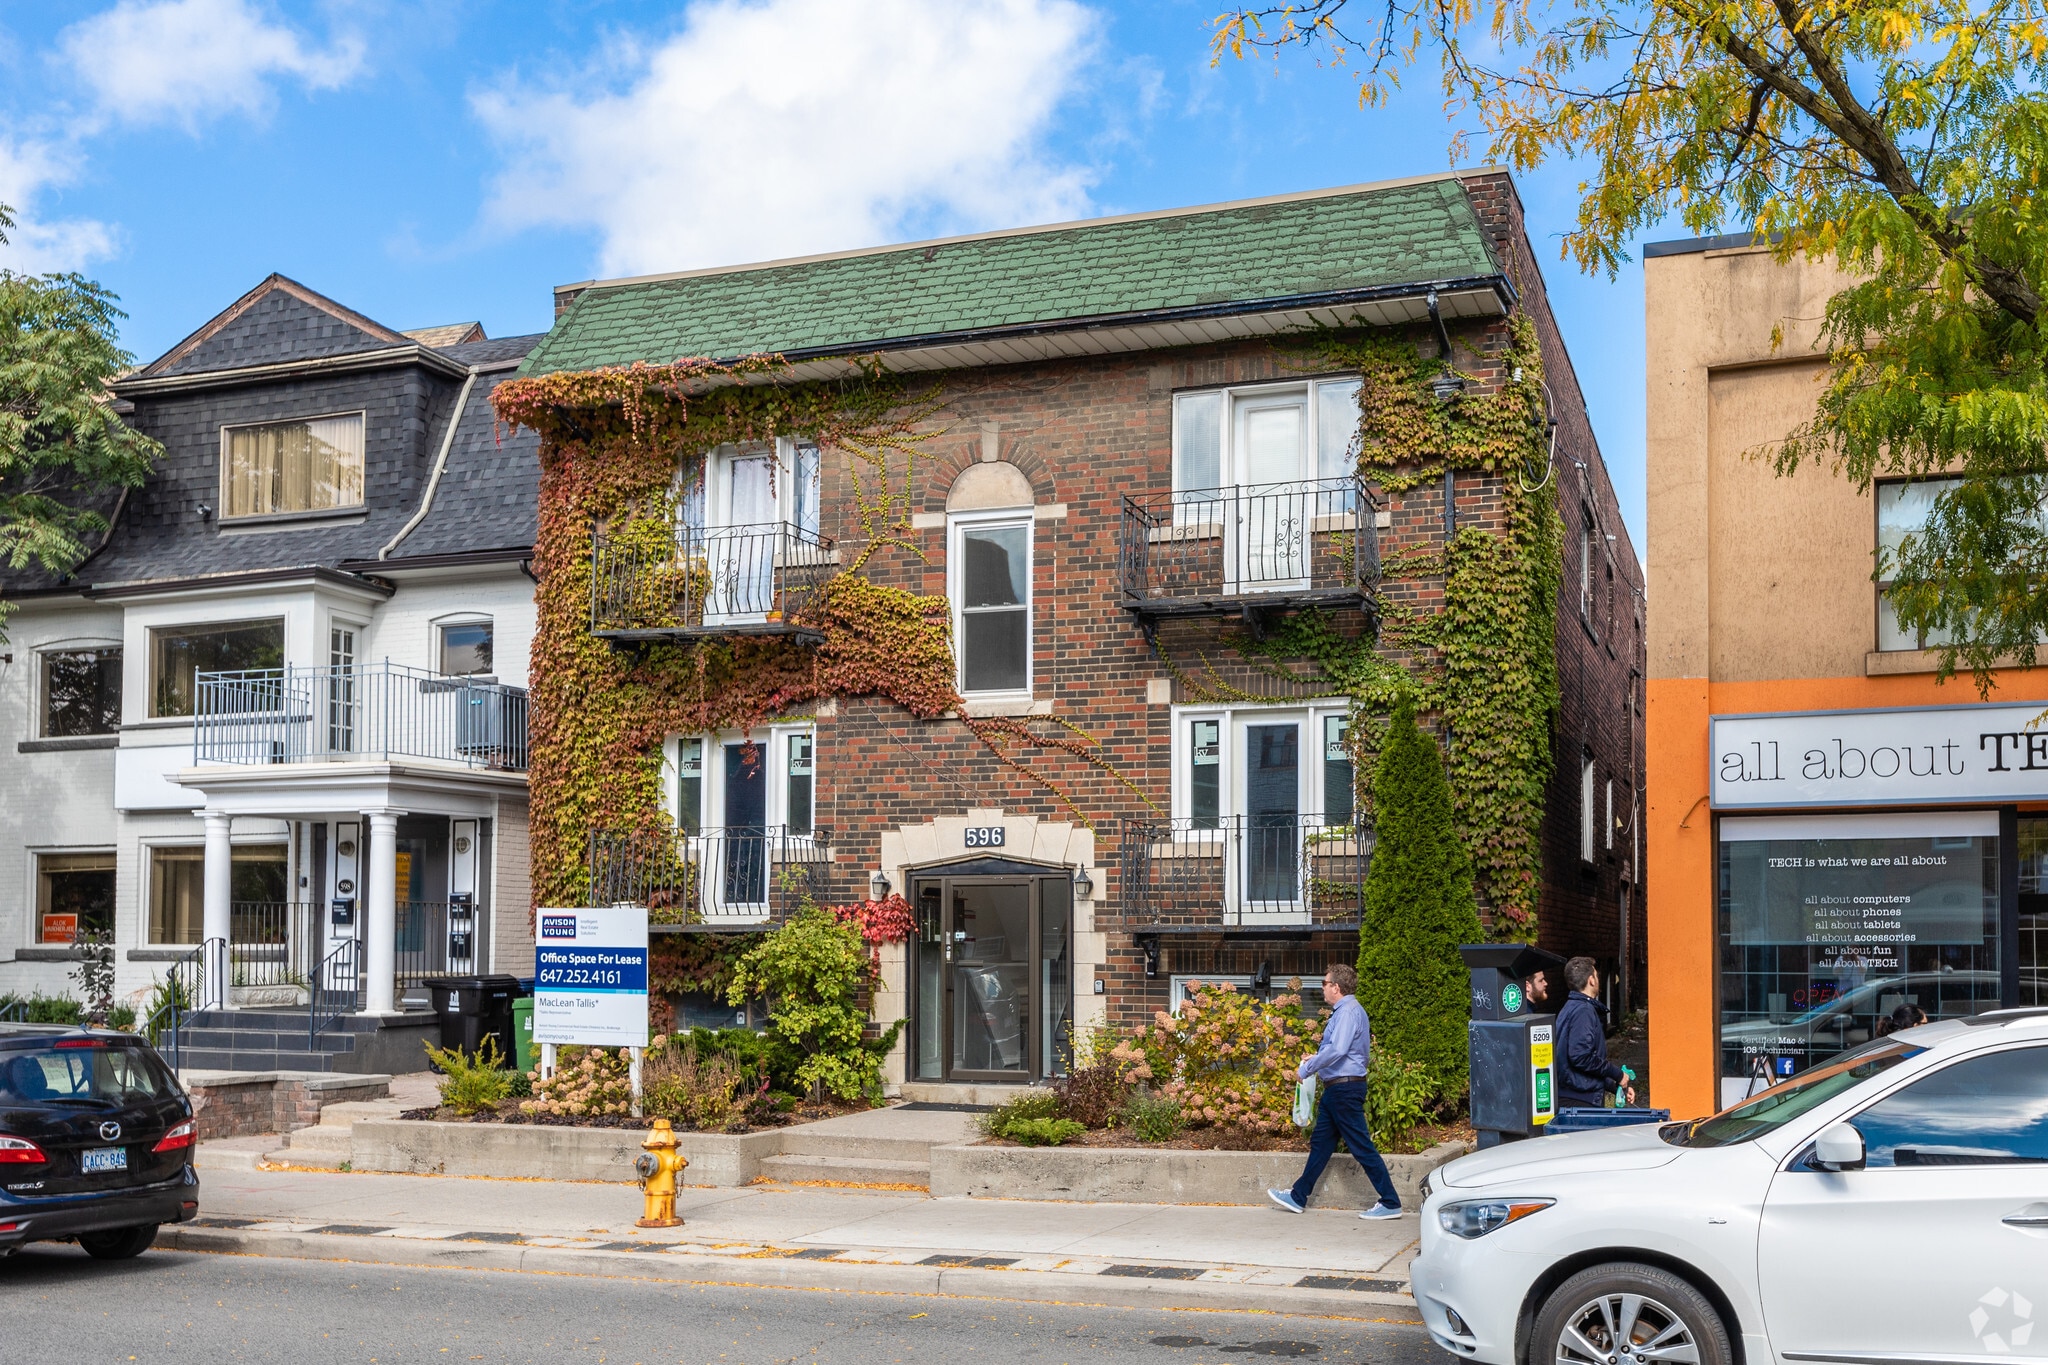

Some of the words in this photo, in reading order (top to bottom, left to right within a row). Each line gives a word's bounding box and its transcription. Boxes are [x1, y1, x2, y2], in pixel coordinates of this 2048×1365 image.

[1720, 741, 1786, 783] all
[1802, 738, 1964, 780] about
[966, 827, 1002, 846] 596
[1768, 857, 1803, 868] TECH
[1804, 857, 1815, 867] is
[1817, 857, 1849, 867] what
[1850, 858, 1868, 867] we
[1870, 858, 1891, 866] are
[1893, 856, 1909, 866] all
[1911, 855, 1947, 866] about
[340, 882, 351, 890] 598
[1804, 896, 1818, 904] all
[1820, 895, 1851, 904] about
[1852, 895, 1911, 906] computers
[1814, 908, 1827, 917] all
[1829, 908, 1860, 917] about
[1862, 907, 1902, 918] phones
[543, 918, 575, 926] AVISON
[1815, 921, 1828, 930] all
[1830, 920, 1861, 929] about
[1863, 920, 1901, 929] tablets
[543, 928, 575, 936] YOUNG
[1806, 934, 1819, 942] all
[1821, 933, 1852, 942] about
[1854, 933, 1917, 942] accessories
[1824, 946, 1838, 955] all
[1840, 946, 1871, 955] about
[1872, 946, 1892, 955] fun
[540, 952, 568, 963] Office
[569, 953, 597, 966] Space
[598, 953, 614, 965] For
[615, 954, 642, 965] Lease
[1818, 959, 1832, 968] all
[1834, 959, 1865, 968] about
[1866, 959, 1899, 968] TECH
[540, 968, 621, 985] 647.252.4161
[1793, 989, 1845, 1003] OPEN
[539, 997, 575, 1008] MacLean
[1533, 1032, 1550, 1042] 5209
[1741, 1036, 1777, 1044] Certified
[1778, 1036, 1796, 1045] Mac
[84, 1154, 105, 1168] CACC
[110, 1152, 126, 1166] 849
